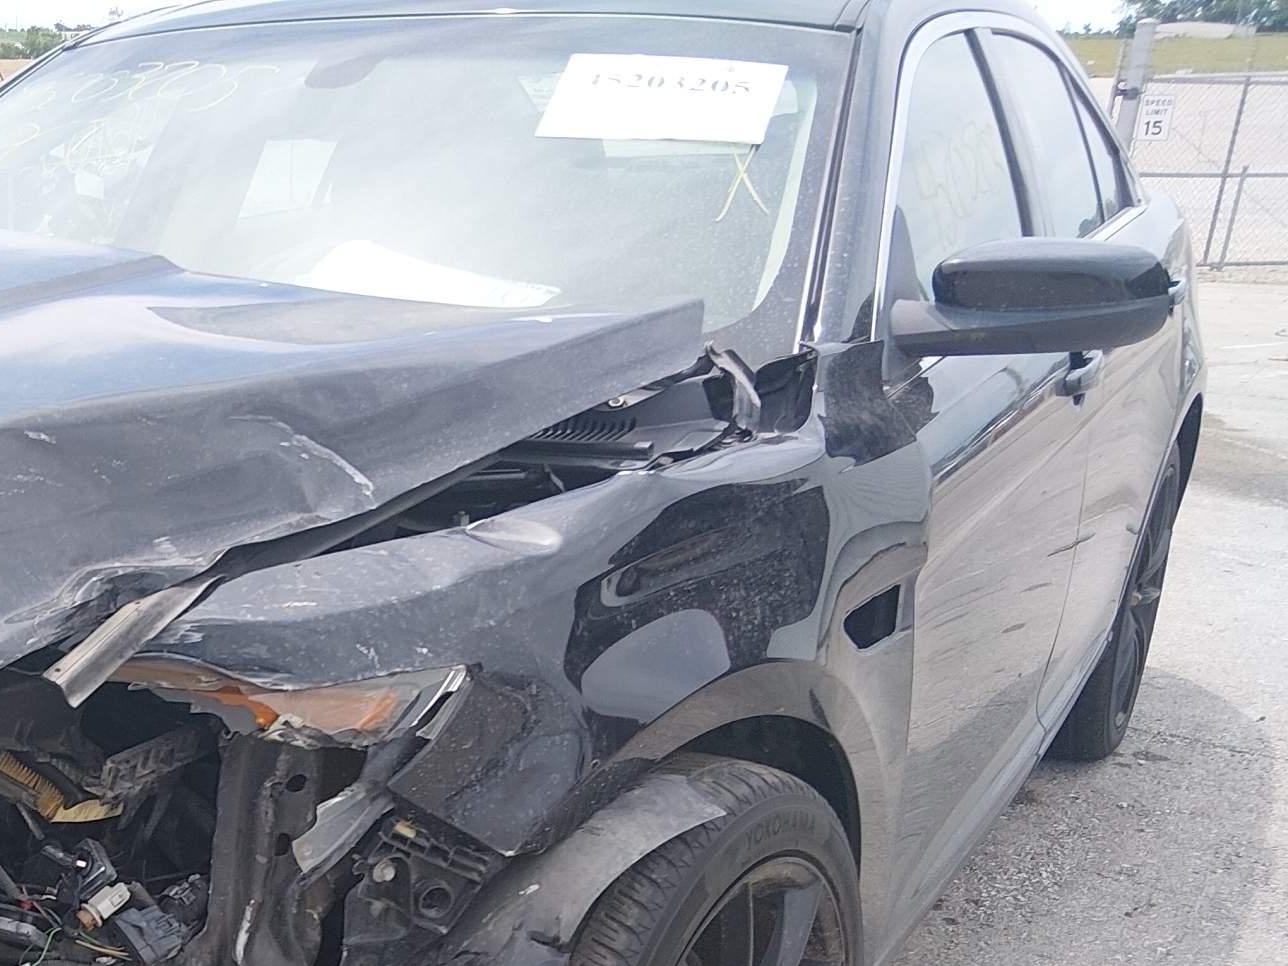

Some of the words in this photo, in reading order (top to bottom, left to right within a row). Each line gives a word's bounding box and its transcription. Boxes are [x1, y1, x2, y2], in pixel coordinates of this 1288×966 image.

[1145, 98, 1173, 106] SPEED
[1145, 108, 1169, 116] LIMIT
[1144, 120, 1163, 136] 15
